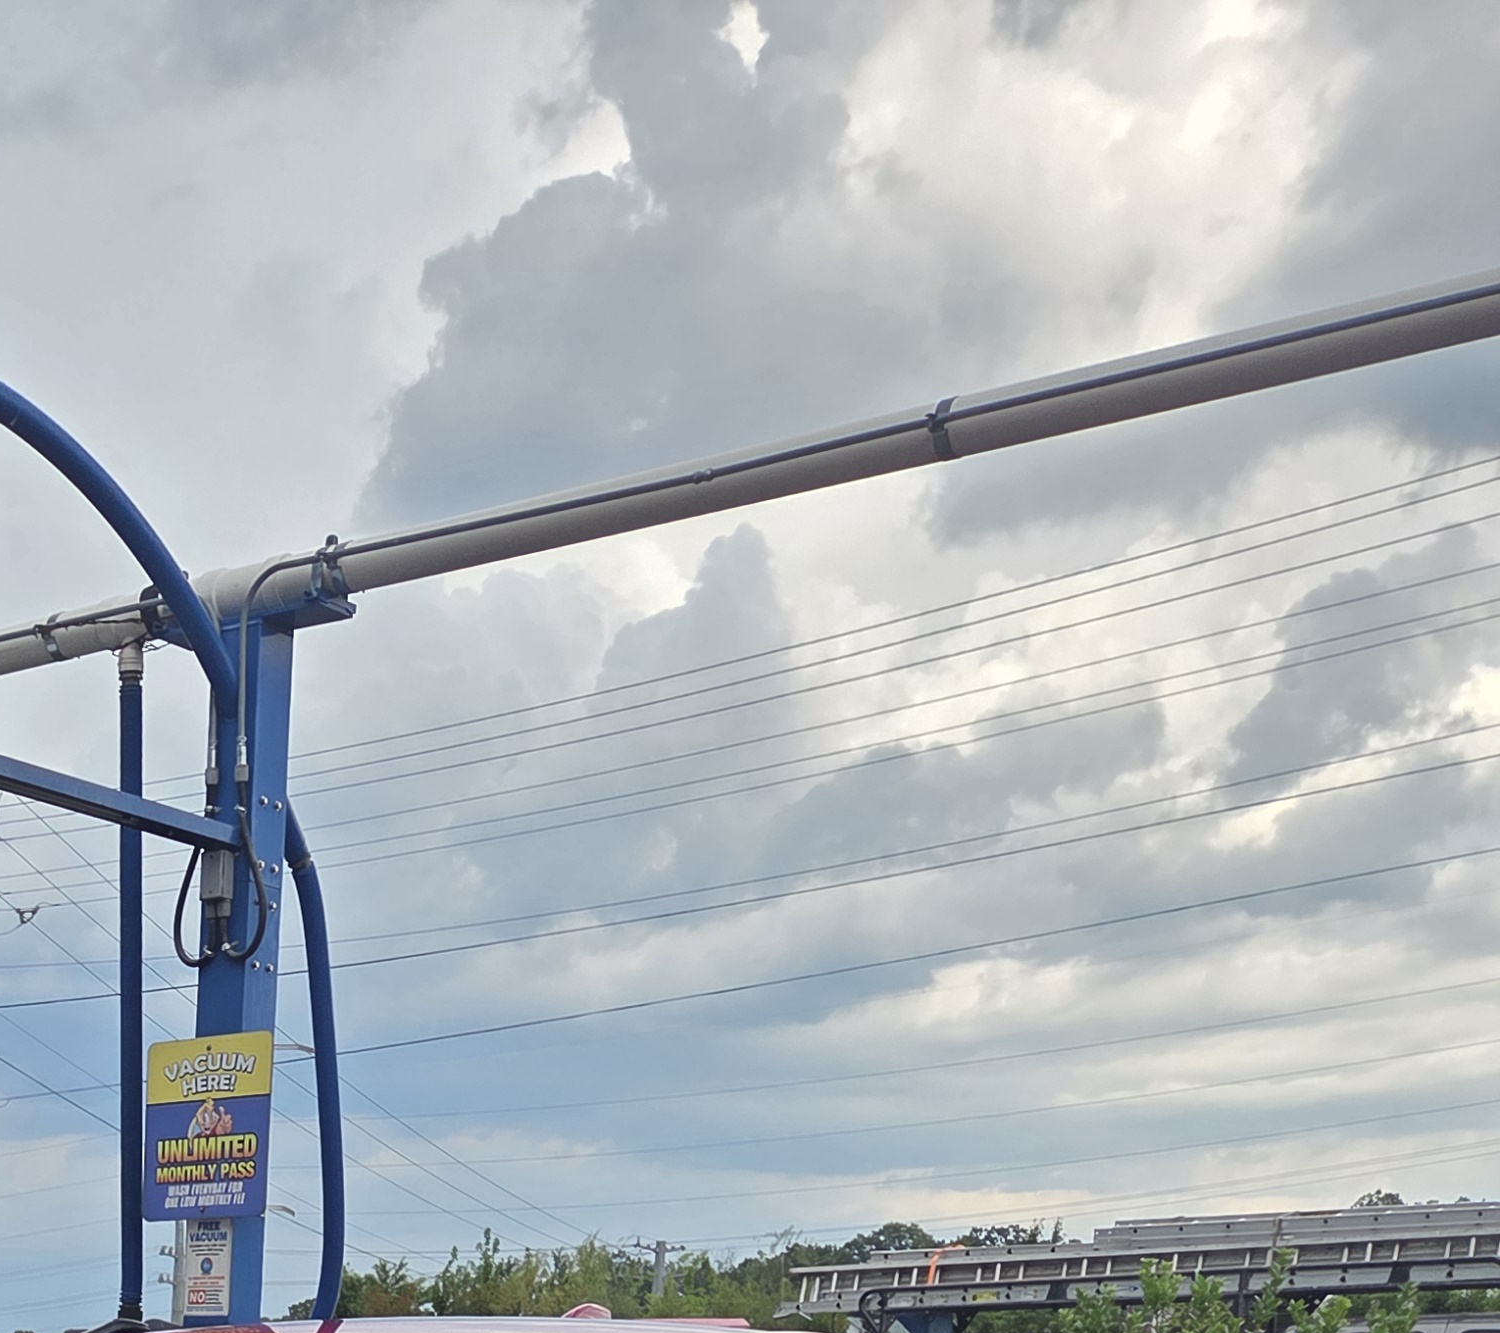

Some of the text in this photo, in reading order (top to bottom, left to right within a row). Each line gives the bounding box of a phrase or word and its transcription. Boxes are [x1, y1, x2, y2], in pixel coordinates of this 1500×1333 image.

[164, 1053, 256, 1082] VACUUM
[182, 1074, 236, 1097] HERE!
[157, 1133, 257, 1164] UNLIMITED
[156, 1161, 255, 1184] MONTHLY PASS
[189, 1231, 228, 1242] VACUUM
[197, 1221, 221, 1232] FREE
[189, 1291, 205, 1303] NO
